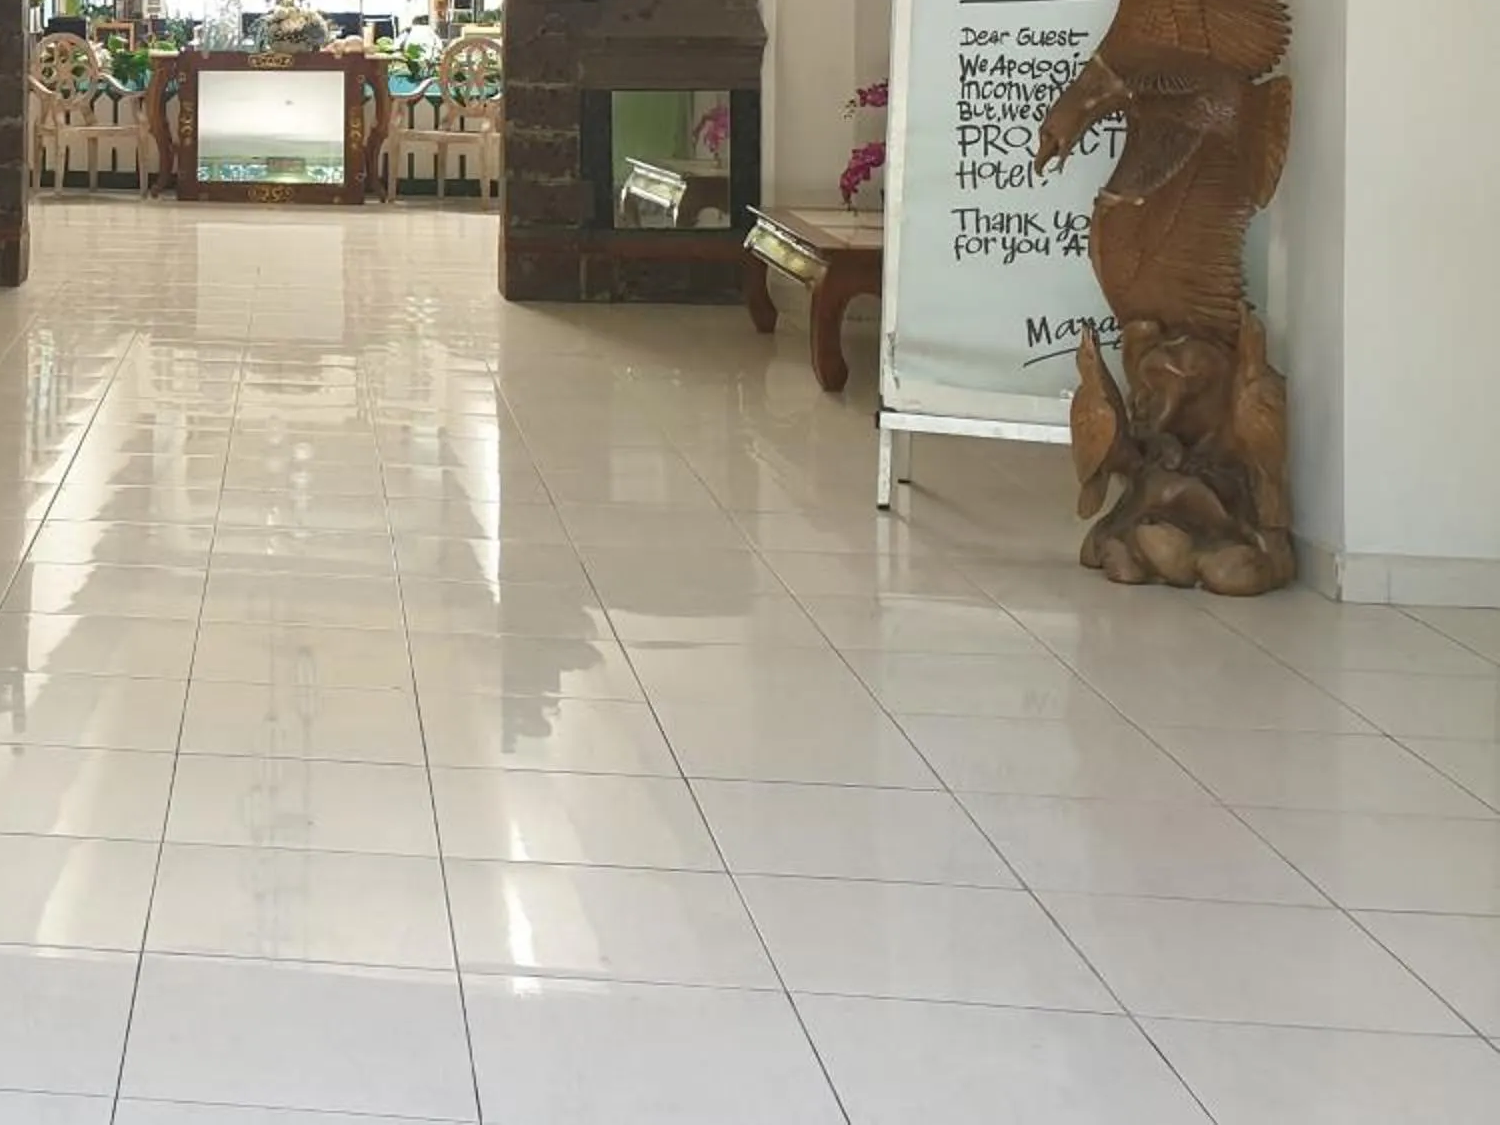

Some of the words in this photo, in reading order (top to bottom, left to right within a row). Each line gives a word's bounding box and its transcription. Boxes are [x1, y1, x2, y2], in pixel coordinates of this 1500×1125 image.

[959, 27, 1010, 46] Dear
[1016, 27, 1089, 46] Guest
[959, 54, 989, 78] We
[989, 52, 1088, 86] Apologi
[959, 77, 1066, 102] inconven
[956, 124, 1127, 159] PROCT
[951, 207, 1047, 236] Thank
[1053, 210, 1092, 242] yo
[954, 234, 997, 260] for
[1001, 237, 1051, 264] you
[1025, 316, 1121, 350] Mana
